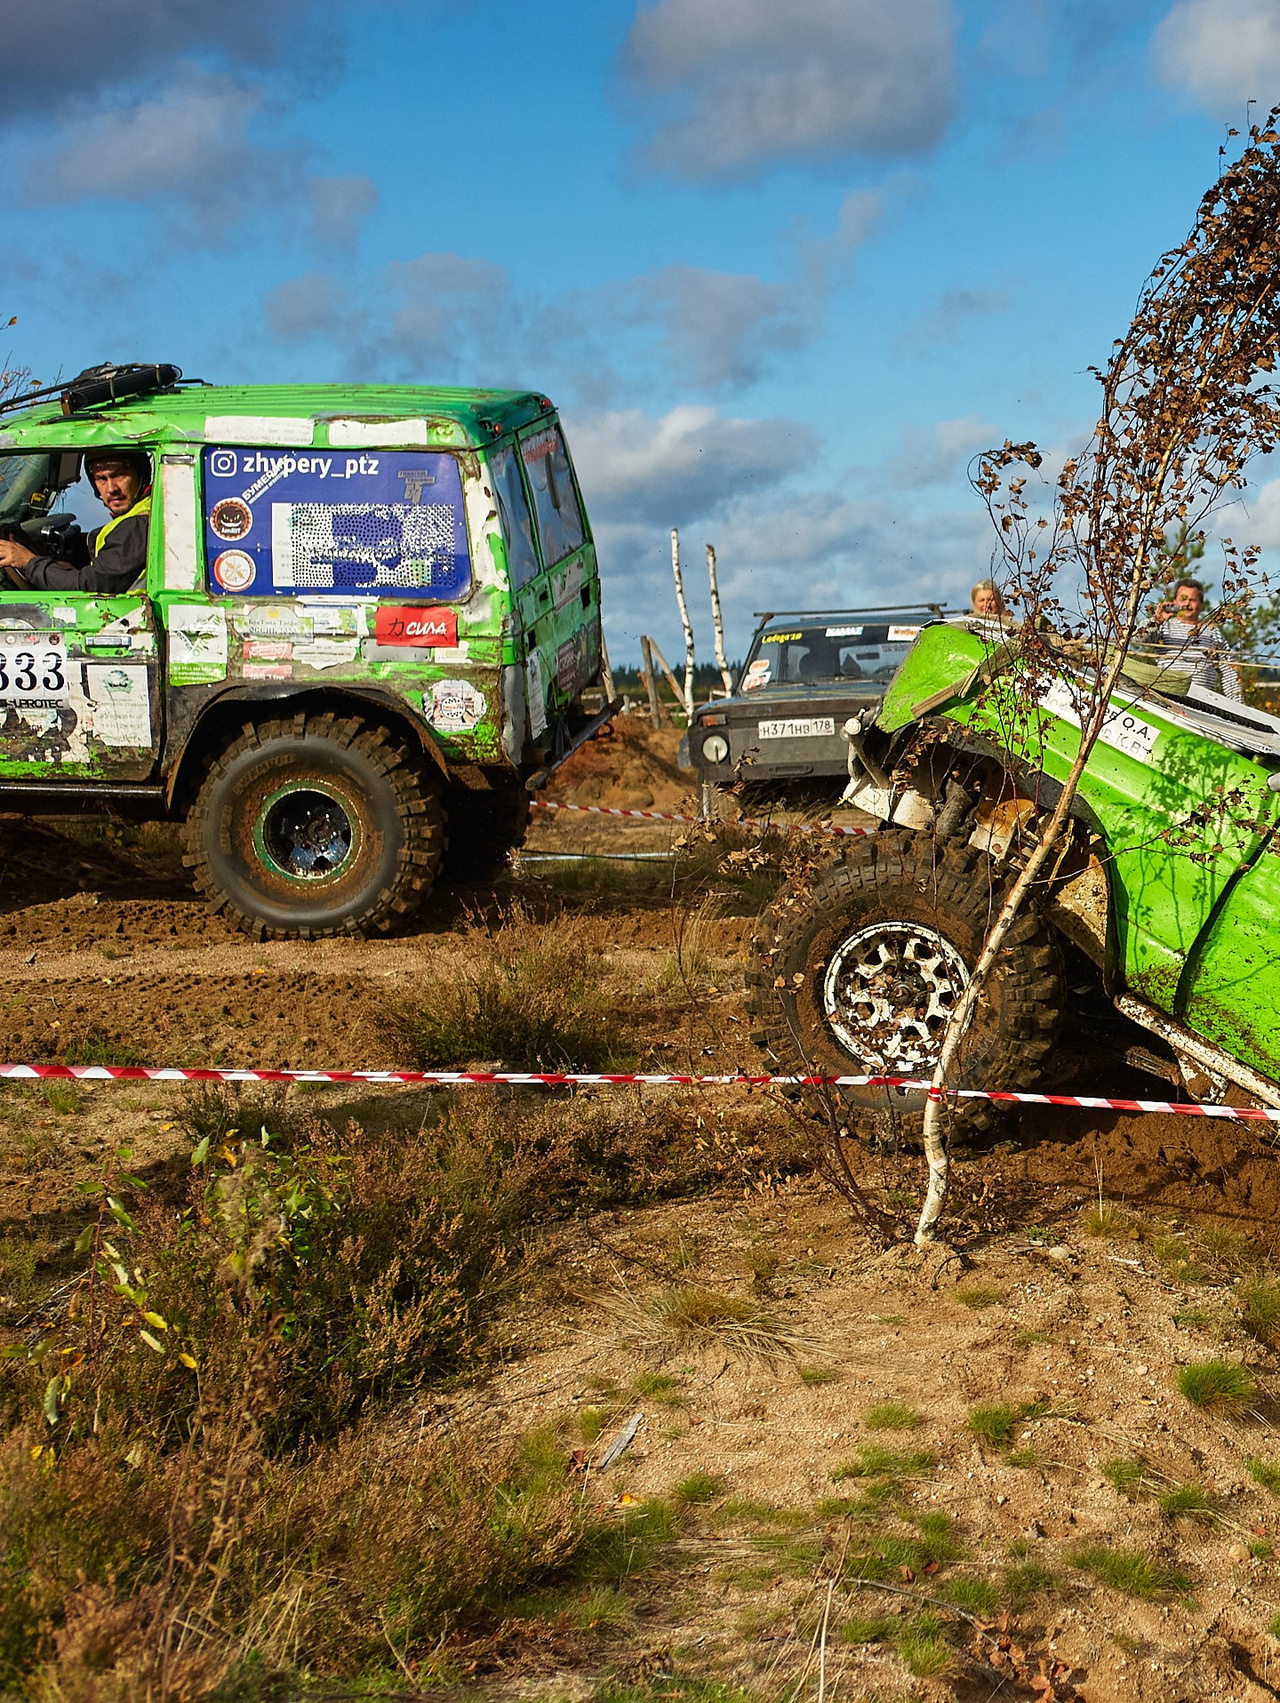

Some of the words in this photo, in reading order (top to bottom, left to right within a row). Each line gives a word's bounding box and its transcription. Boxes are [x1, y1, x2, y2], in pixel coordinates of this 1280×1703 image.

[243, 452, 379, 479] zhypery_ptz
[388, 617, 405, 636] 力
[405, 621, 448, 638] СИЛА
[6, 699, 64, 709] SUPROTEC
[813, 720, 831, 731] 178
